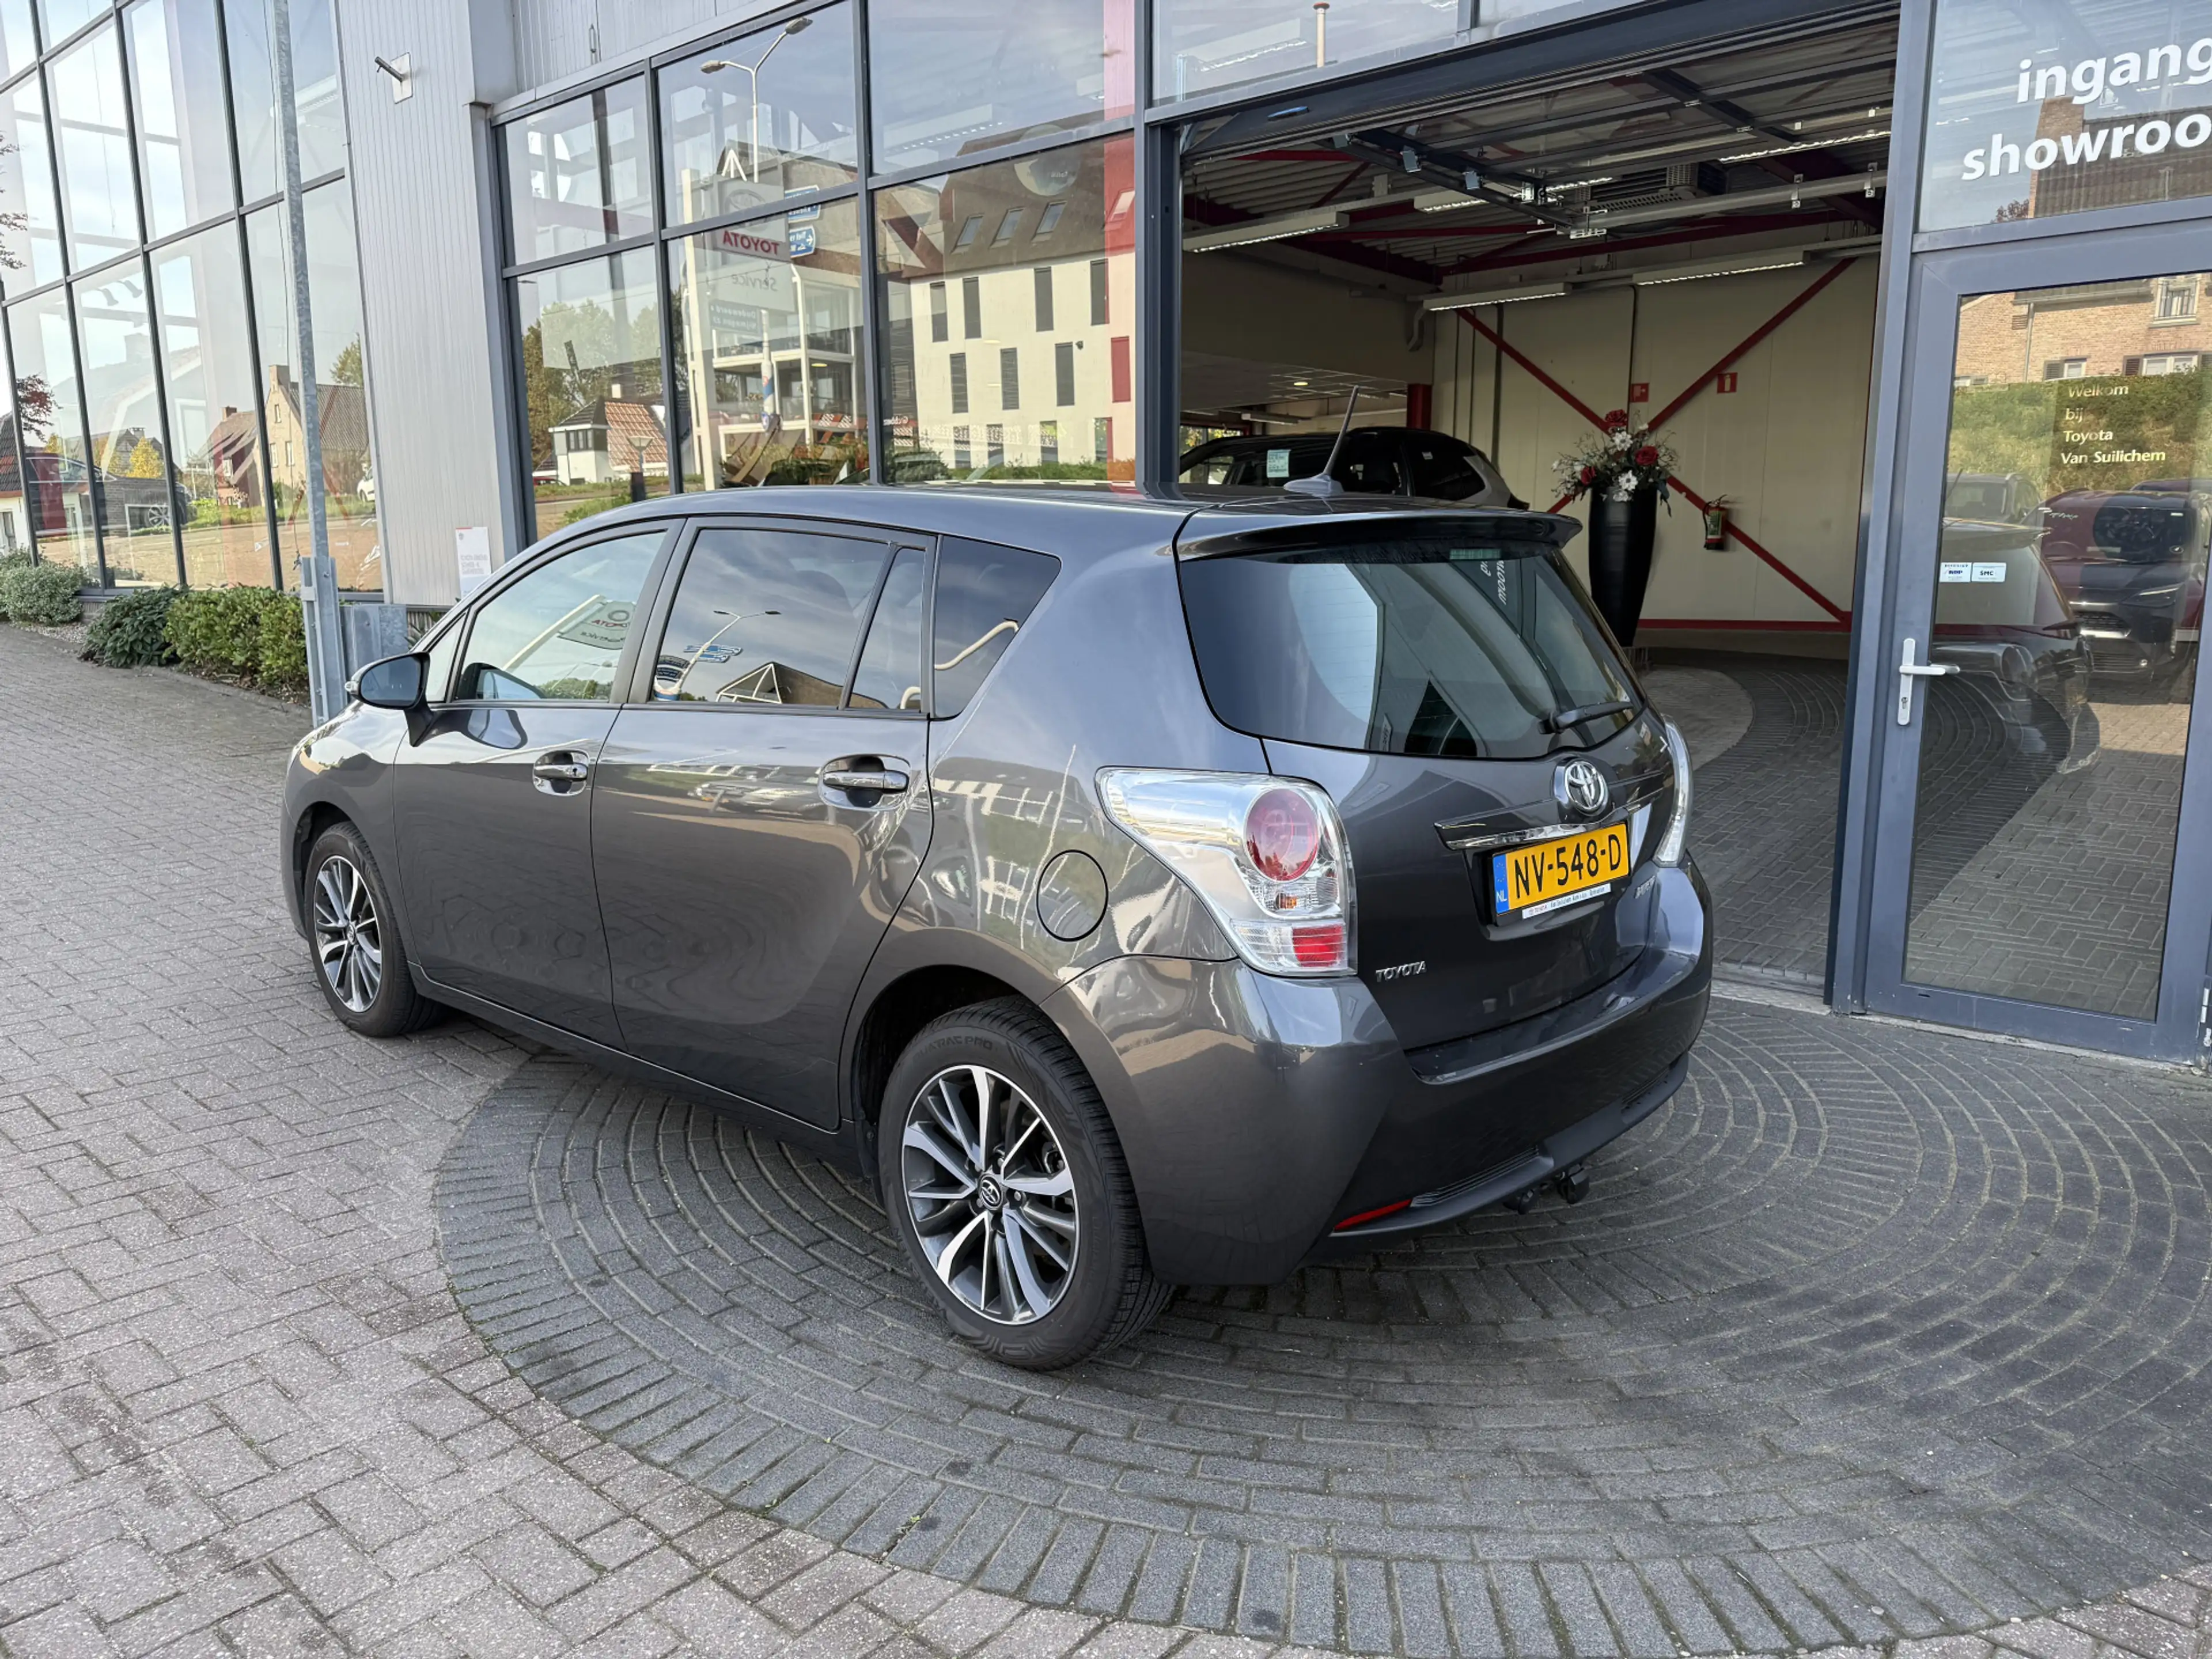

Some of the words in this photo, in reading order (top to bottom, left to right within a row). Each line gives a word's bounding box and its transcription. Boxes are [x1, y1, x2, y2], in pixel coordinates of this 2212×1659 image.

[2016, 37, 2212, 105] ingang
[2068, 385, 2129, 397] Welkom
[2065, 408, 2084, 423] bij
[2063, 430, 2113, 445] Toyota
[2061, 452, 2088, 464] Van
[2093, 449, 2166, 464] Suilichem
[1514, 834, 1622, 899] NV-548-D
[1497, 891, 1508, 903] NL
[1376, 961, 1427, 983] TOYOTA
